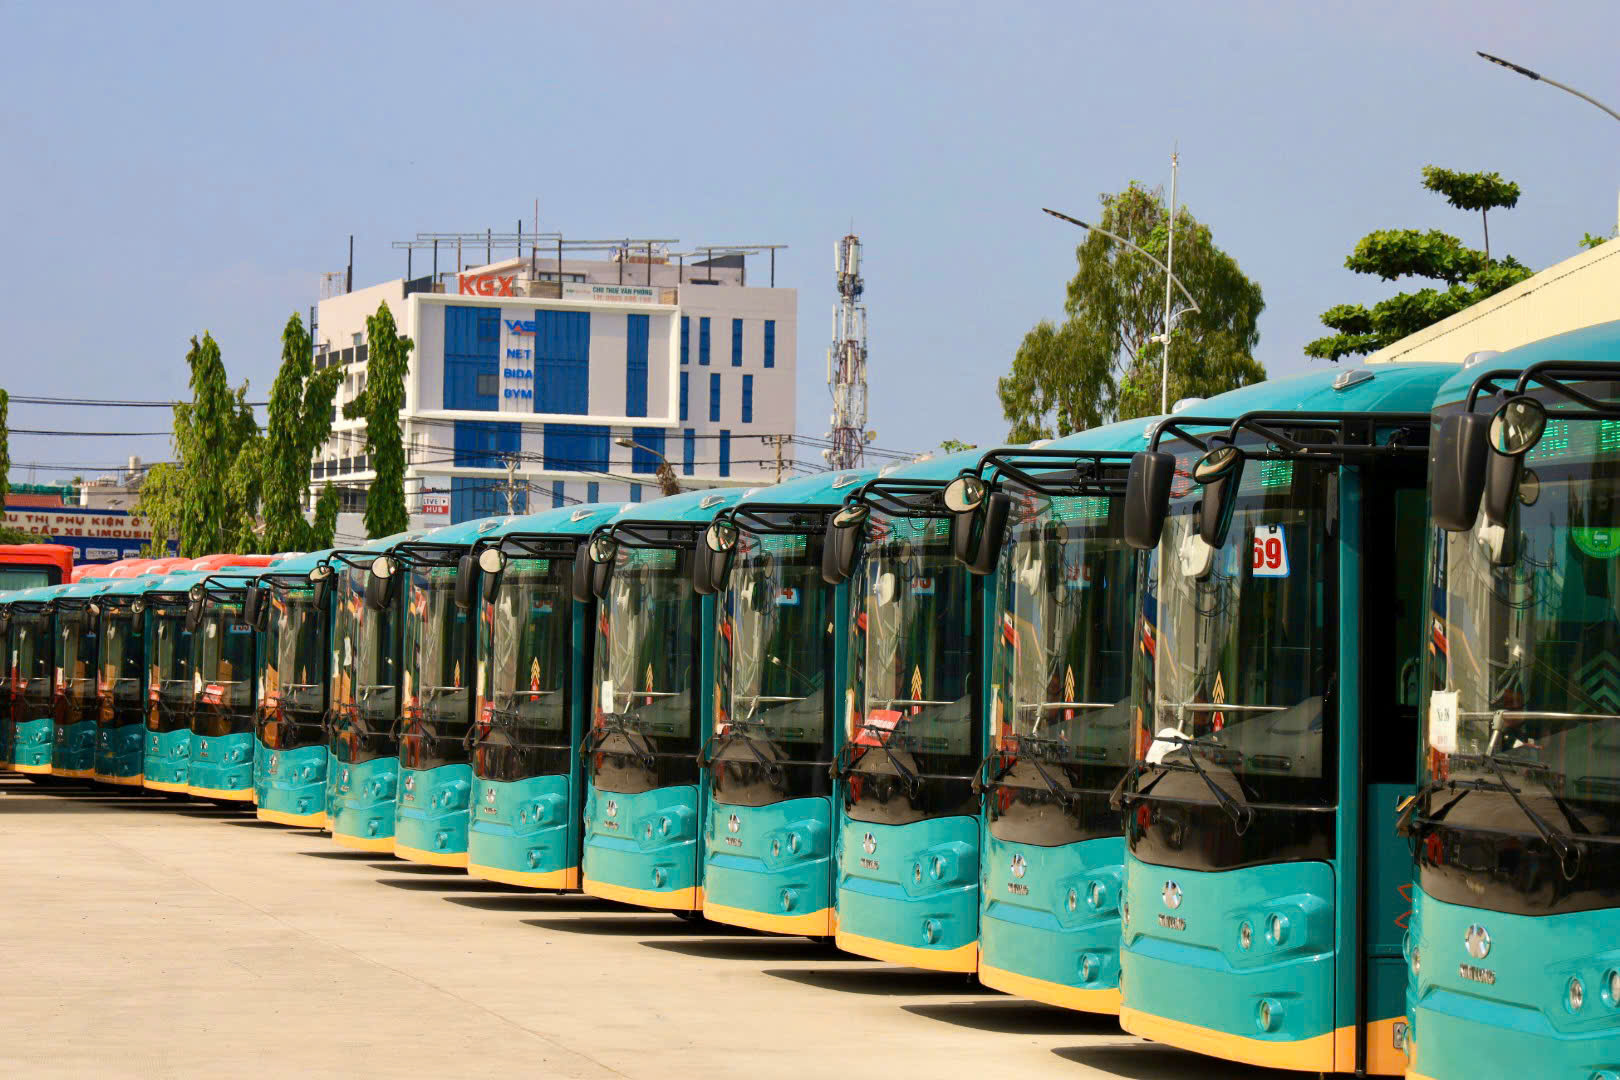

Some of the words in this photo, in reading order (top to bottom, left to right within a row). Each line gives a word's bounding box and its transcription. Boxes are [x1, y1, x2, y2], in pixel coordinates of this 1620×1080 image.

[459, 274, 513, 297] KGX
[506, 348, 532, 360] NET
[504, 368, 533, 380] BIDA
[65, 527, 82, 537] XE
